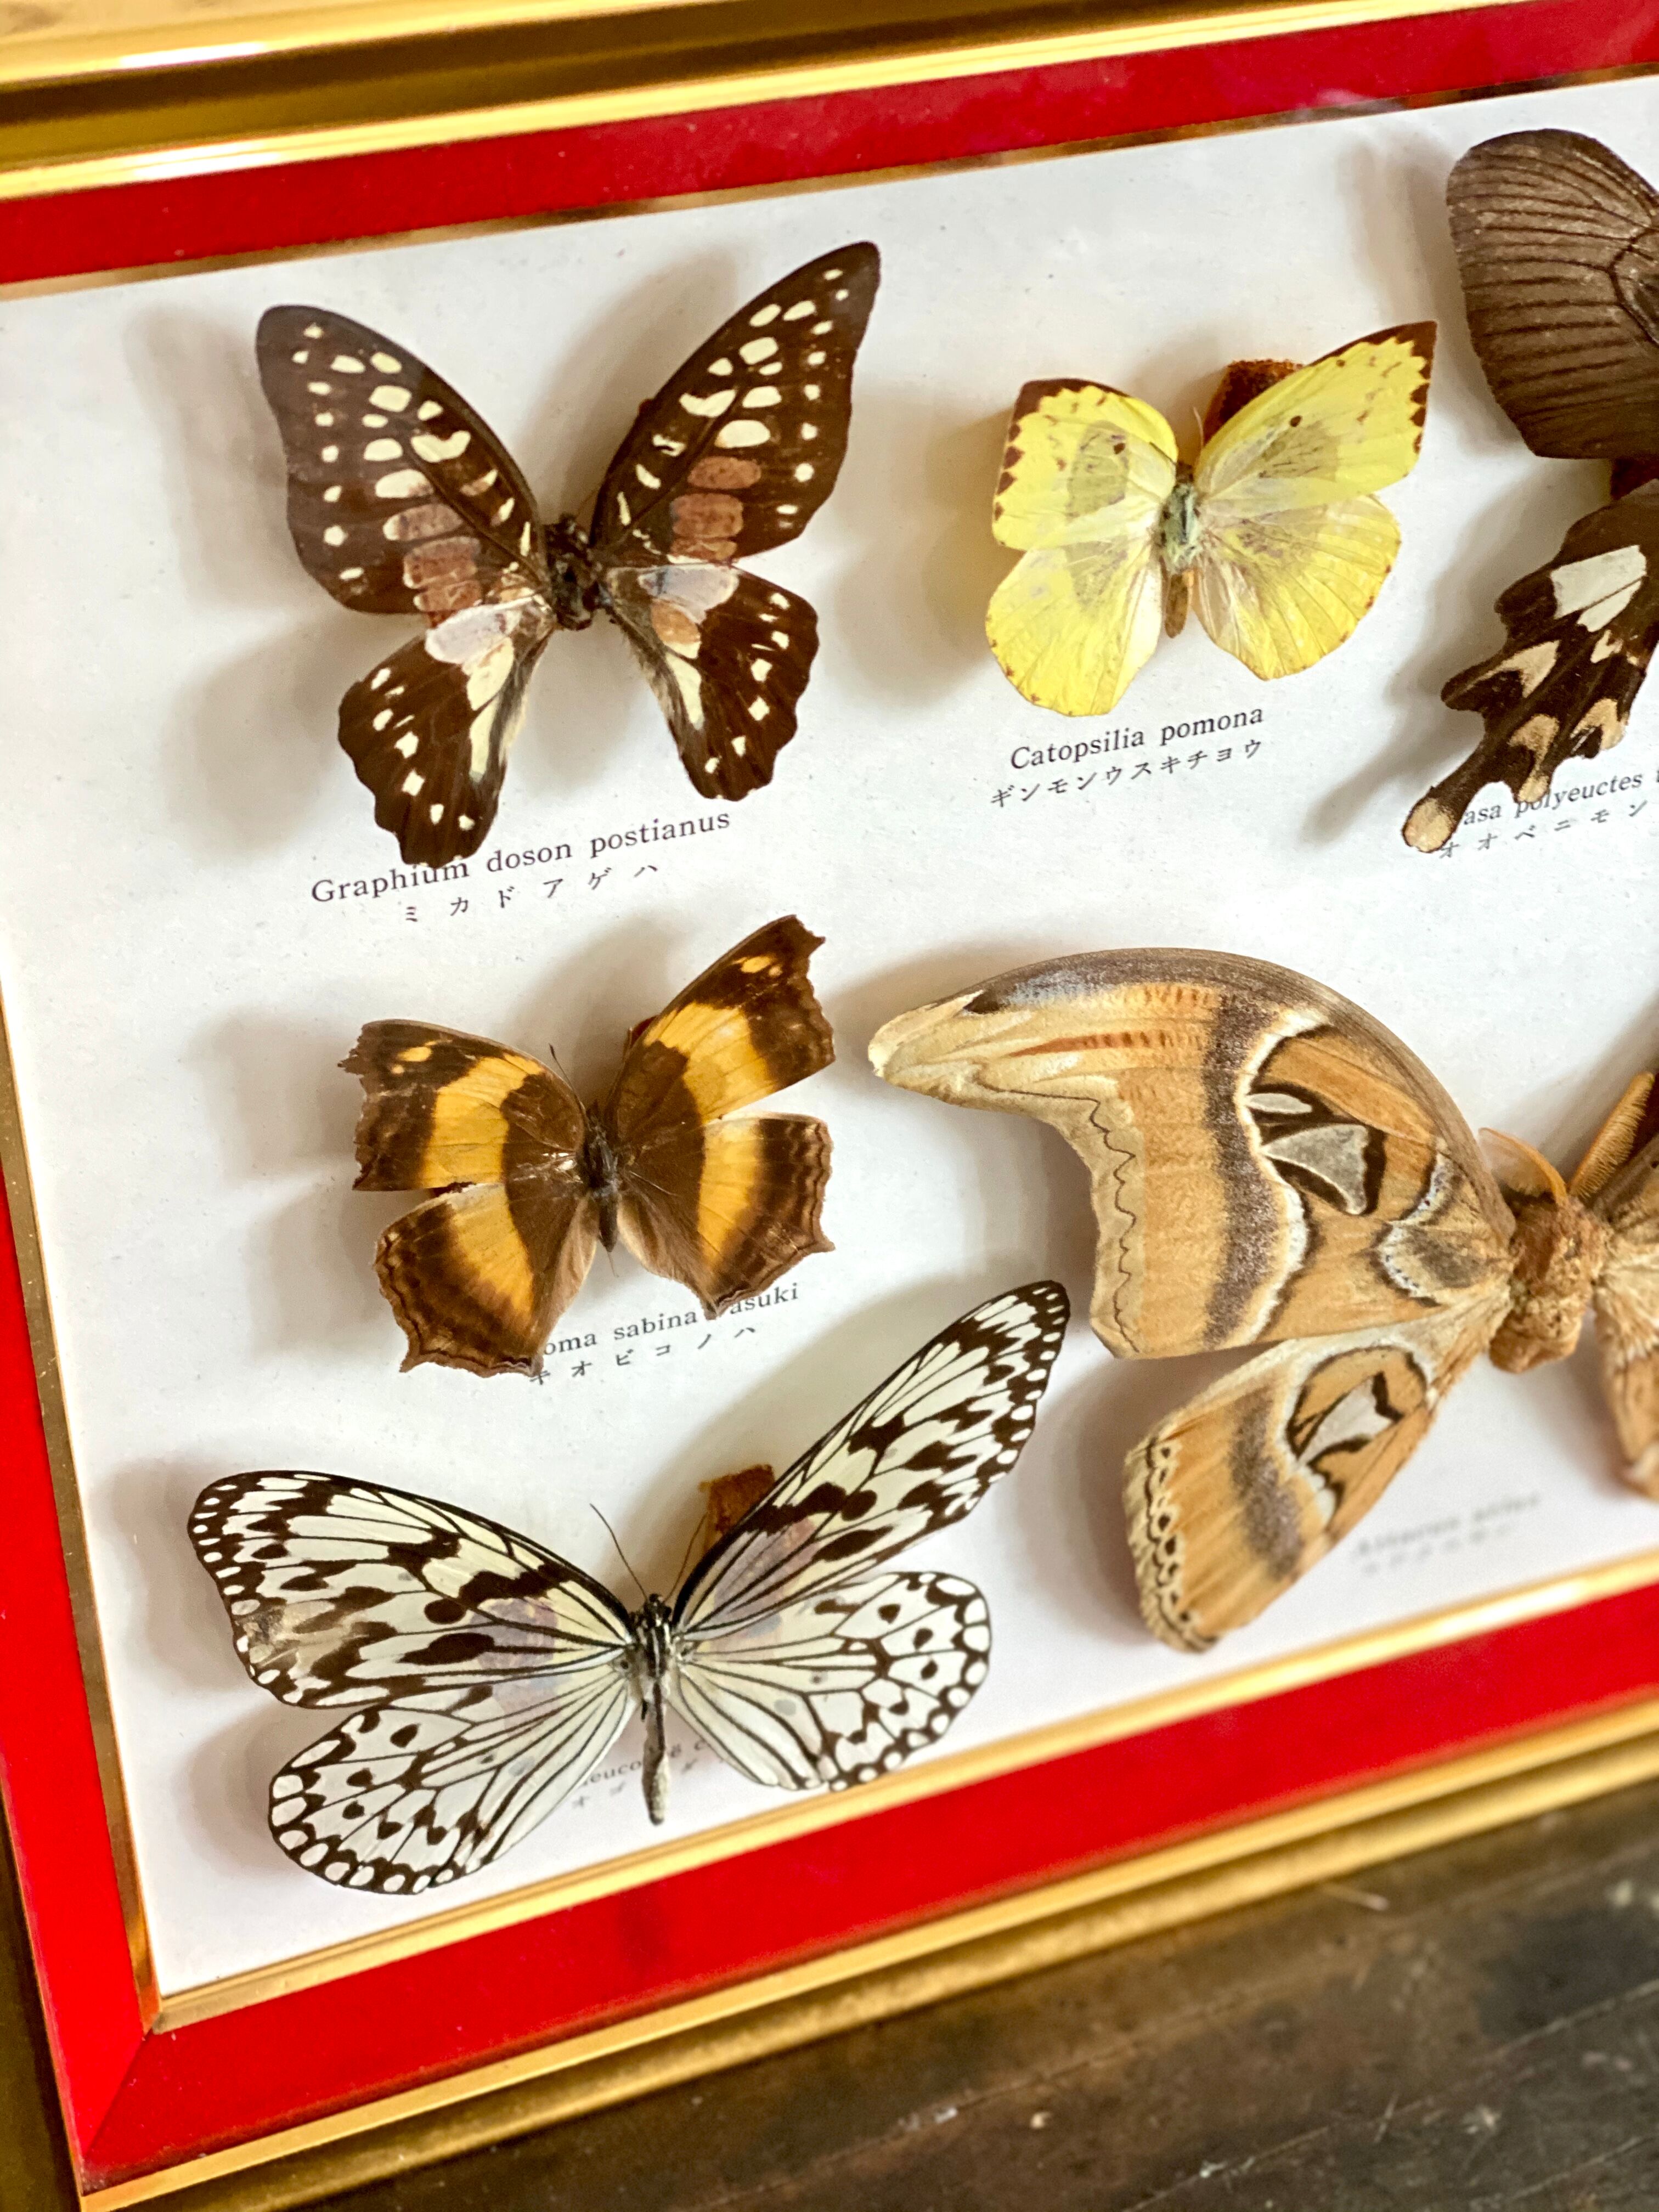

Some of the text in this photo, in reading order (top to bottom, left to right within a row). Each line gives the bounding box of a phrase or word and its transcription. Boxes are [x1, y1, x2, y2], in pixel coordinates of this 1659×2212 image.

[990, 738, 1262, 808] ギンモンウスキチョウ
[1010, 708, 1264, 769] Catopsilia pomona
[1463, 804, 1502, 825] asa
[311, 812, 731, 903] Graphium doson postianus
[544, 1282, 799, 1356] oma sabina asuki
